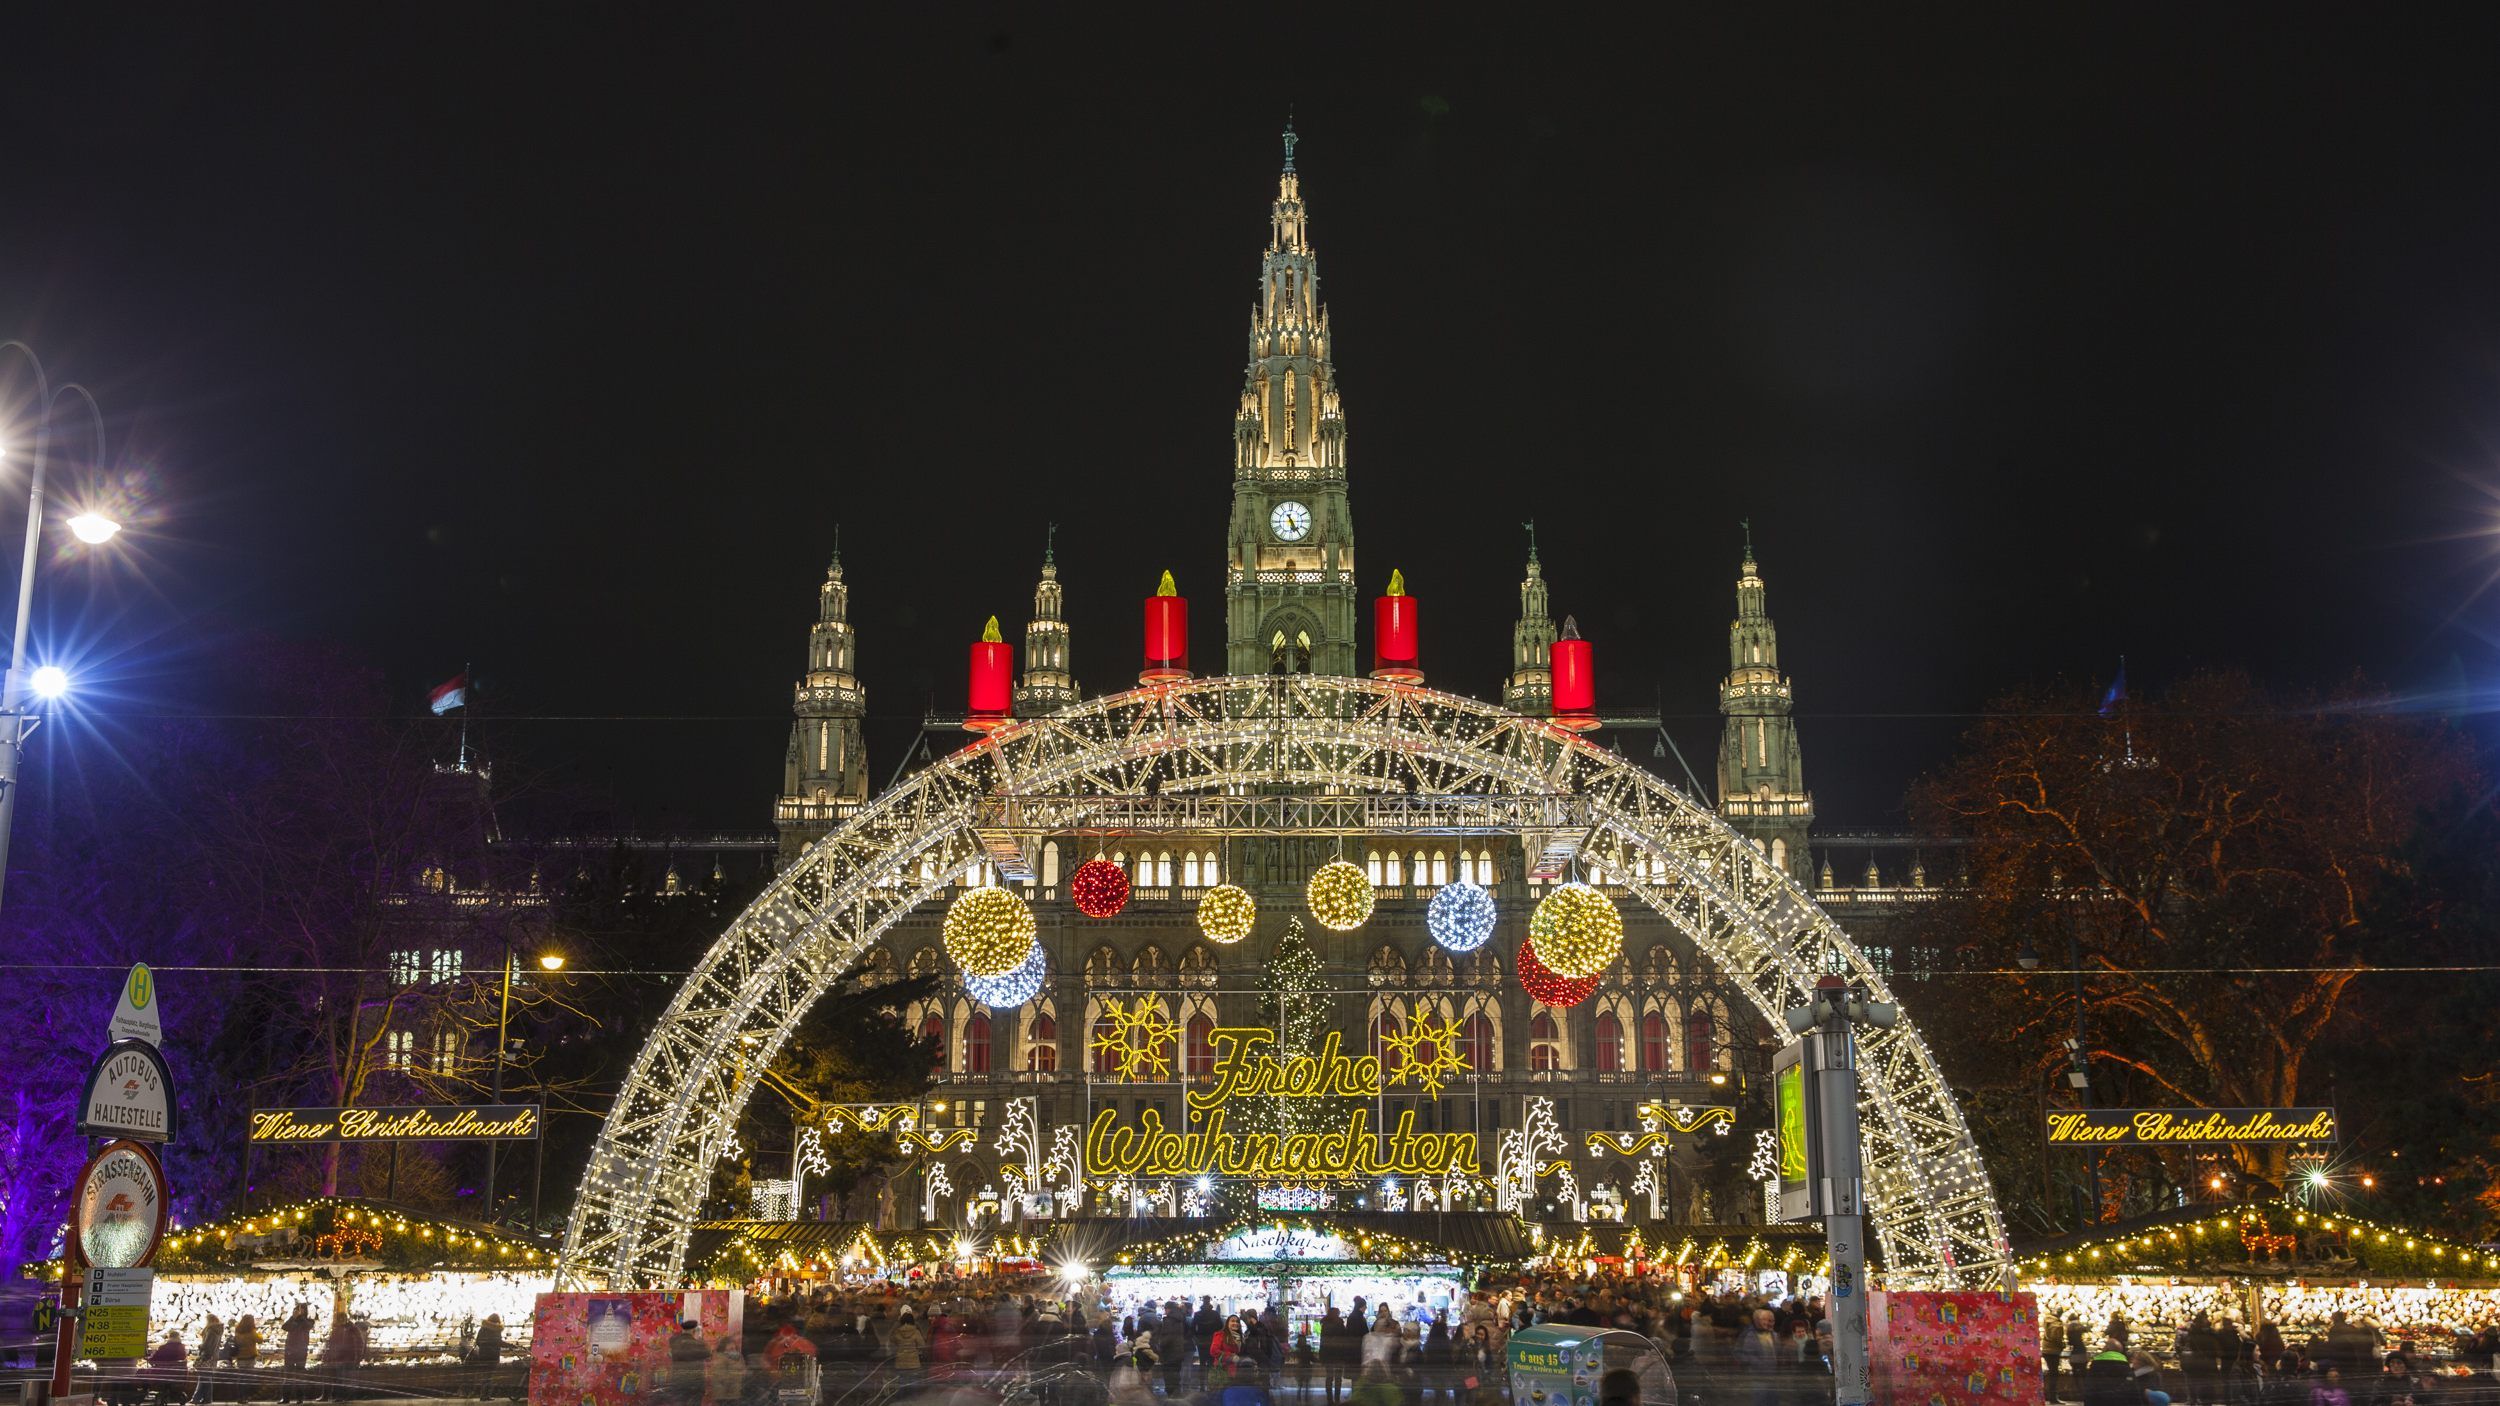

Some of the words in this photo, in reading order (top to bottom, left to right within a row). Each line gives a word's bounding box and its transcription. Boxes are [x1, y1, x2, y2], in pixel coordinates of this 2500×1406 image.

[133, 972, 147, 1001] H
[108, 1056, 158, 1091] AUTOBUS
[1187, 1027, 1381, 1109] Frohe
[94, 1103, 162, 1128] HALTESTELLE
[252, 1111, 334, 1140] Wiener
[338, 1108, 537, 1138] Christkindlmarkt
[2047, 1113, 2130, 1142] Wiener
[2133, 1111, 2335, 1140] Christkindlmarkt
[1086, 1108, 1480, 1175] Weihnachten
[87, 1158, 155, 1207] STRASSENBAHN
[89, 1308, 109, 1317] N25
[84, 1346, 106, 1356] N66
[85, 1334, 107, 1343] N60
[1520, 1350, 1526, 1363] 6
[1528, 1353, 1545, 1366] aus
[1547, 1353, 1558, 1366] 45
